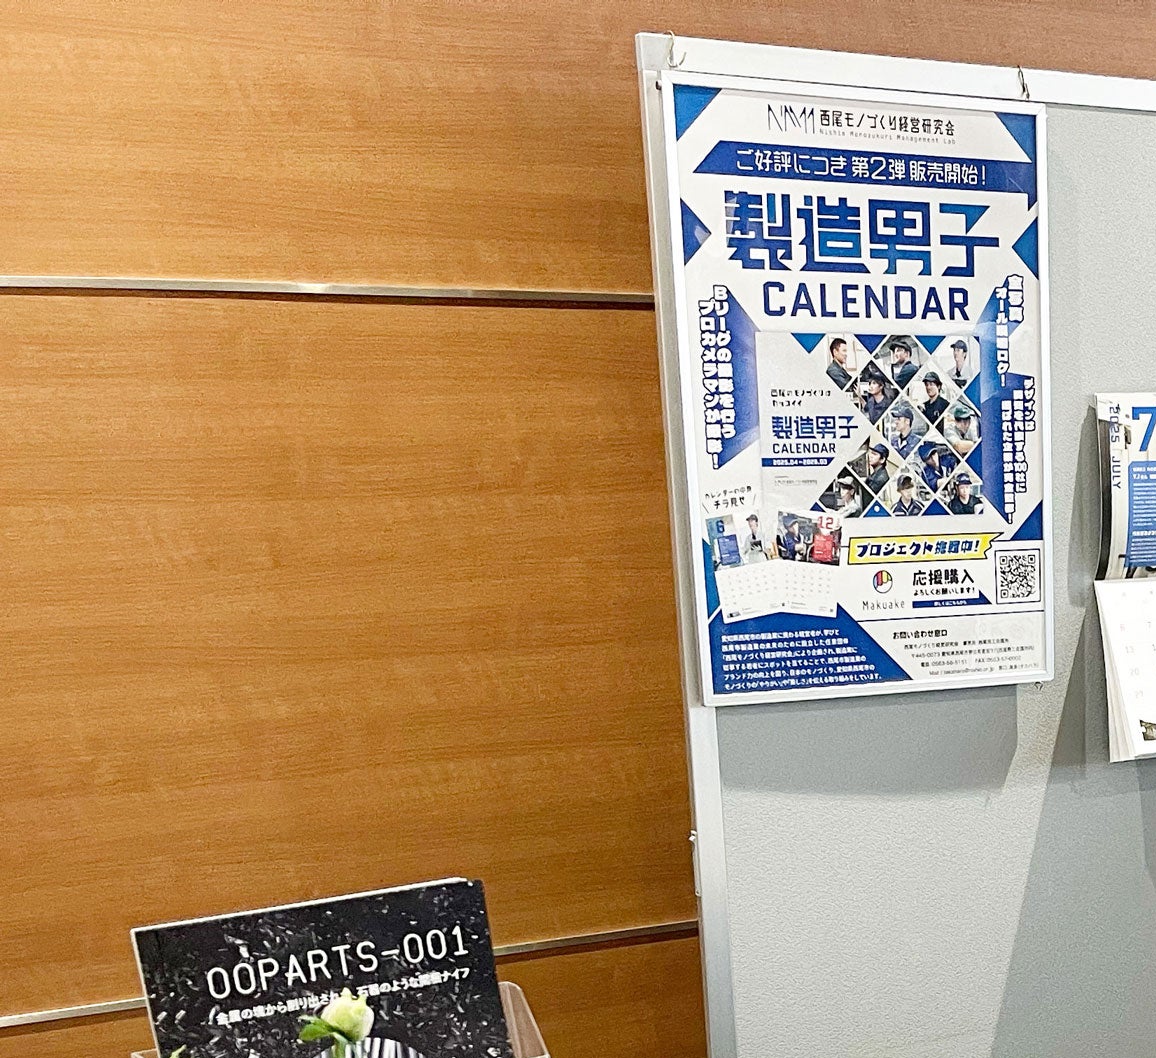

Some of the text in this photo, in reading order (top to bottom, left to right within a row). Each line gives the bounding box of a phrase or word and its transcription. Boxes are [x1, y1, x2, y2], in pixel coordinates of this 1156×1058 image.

[819, 110, 956, 136] 西尾モノづくり経営研究会
[736, 149, 847, 177] ご好評につき
[851, 156, 907, 181] 第2弾
[724, 190, 1000, 277] 製造男子
[763, 281, 970, 322] CALENDAR
[772, 416, 858, 439] 製造男子
[773, 443, 836, 454] CALENDAR
[1112, 455, 1121, 489] JULY
[912, 569, 975, 586] 応援購入
[862, 600, 905, 611] Makuake
